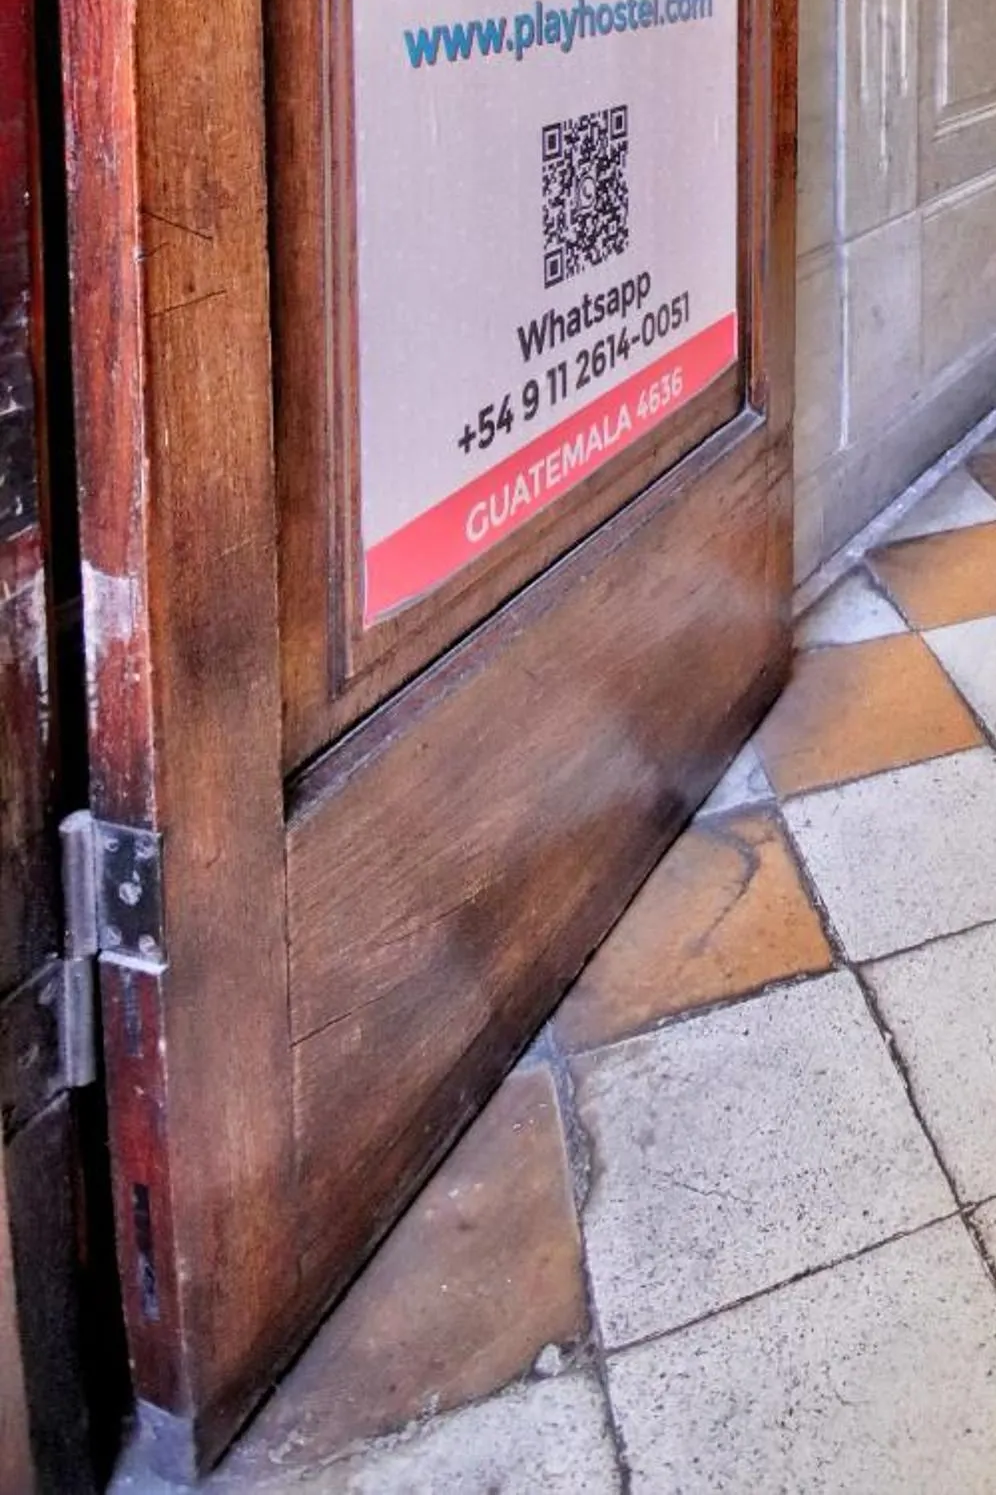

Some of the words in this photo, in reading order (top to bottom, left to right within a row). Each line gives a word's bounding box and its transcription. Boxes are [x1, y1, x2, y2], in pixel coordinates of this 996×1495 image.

[457, 393, 515, 455] +54
[521, 378, 540, 422] 9
[546, 361, 568, 406] 11
[575, 289, 690, 390] 2614-0051
[517, 271, 651, 363] Whatsapp
[465, 404, 633, 543] GUATEMALA
